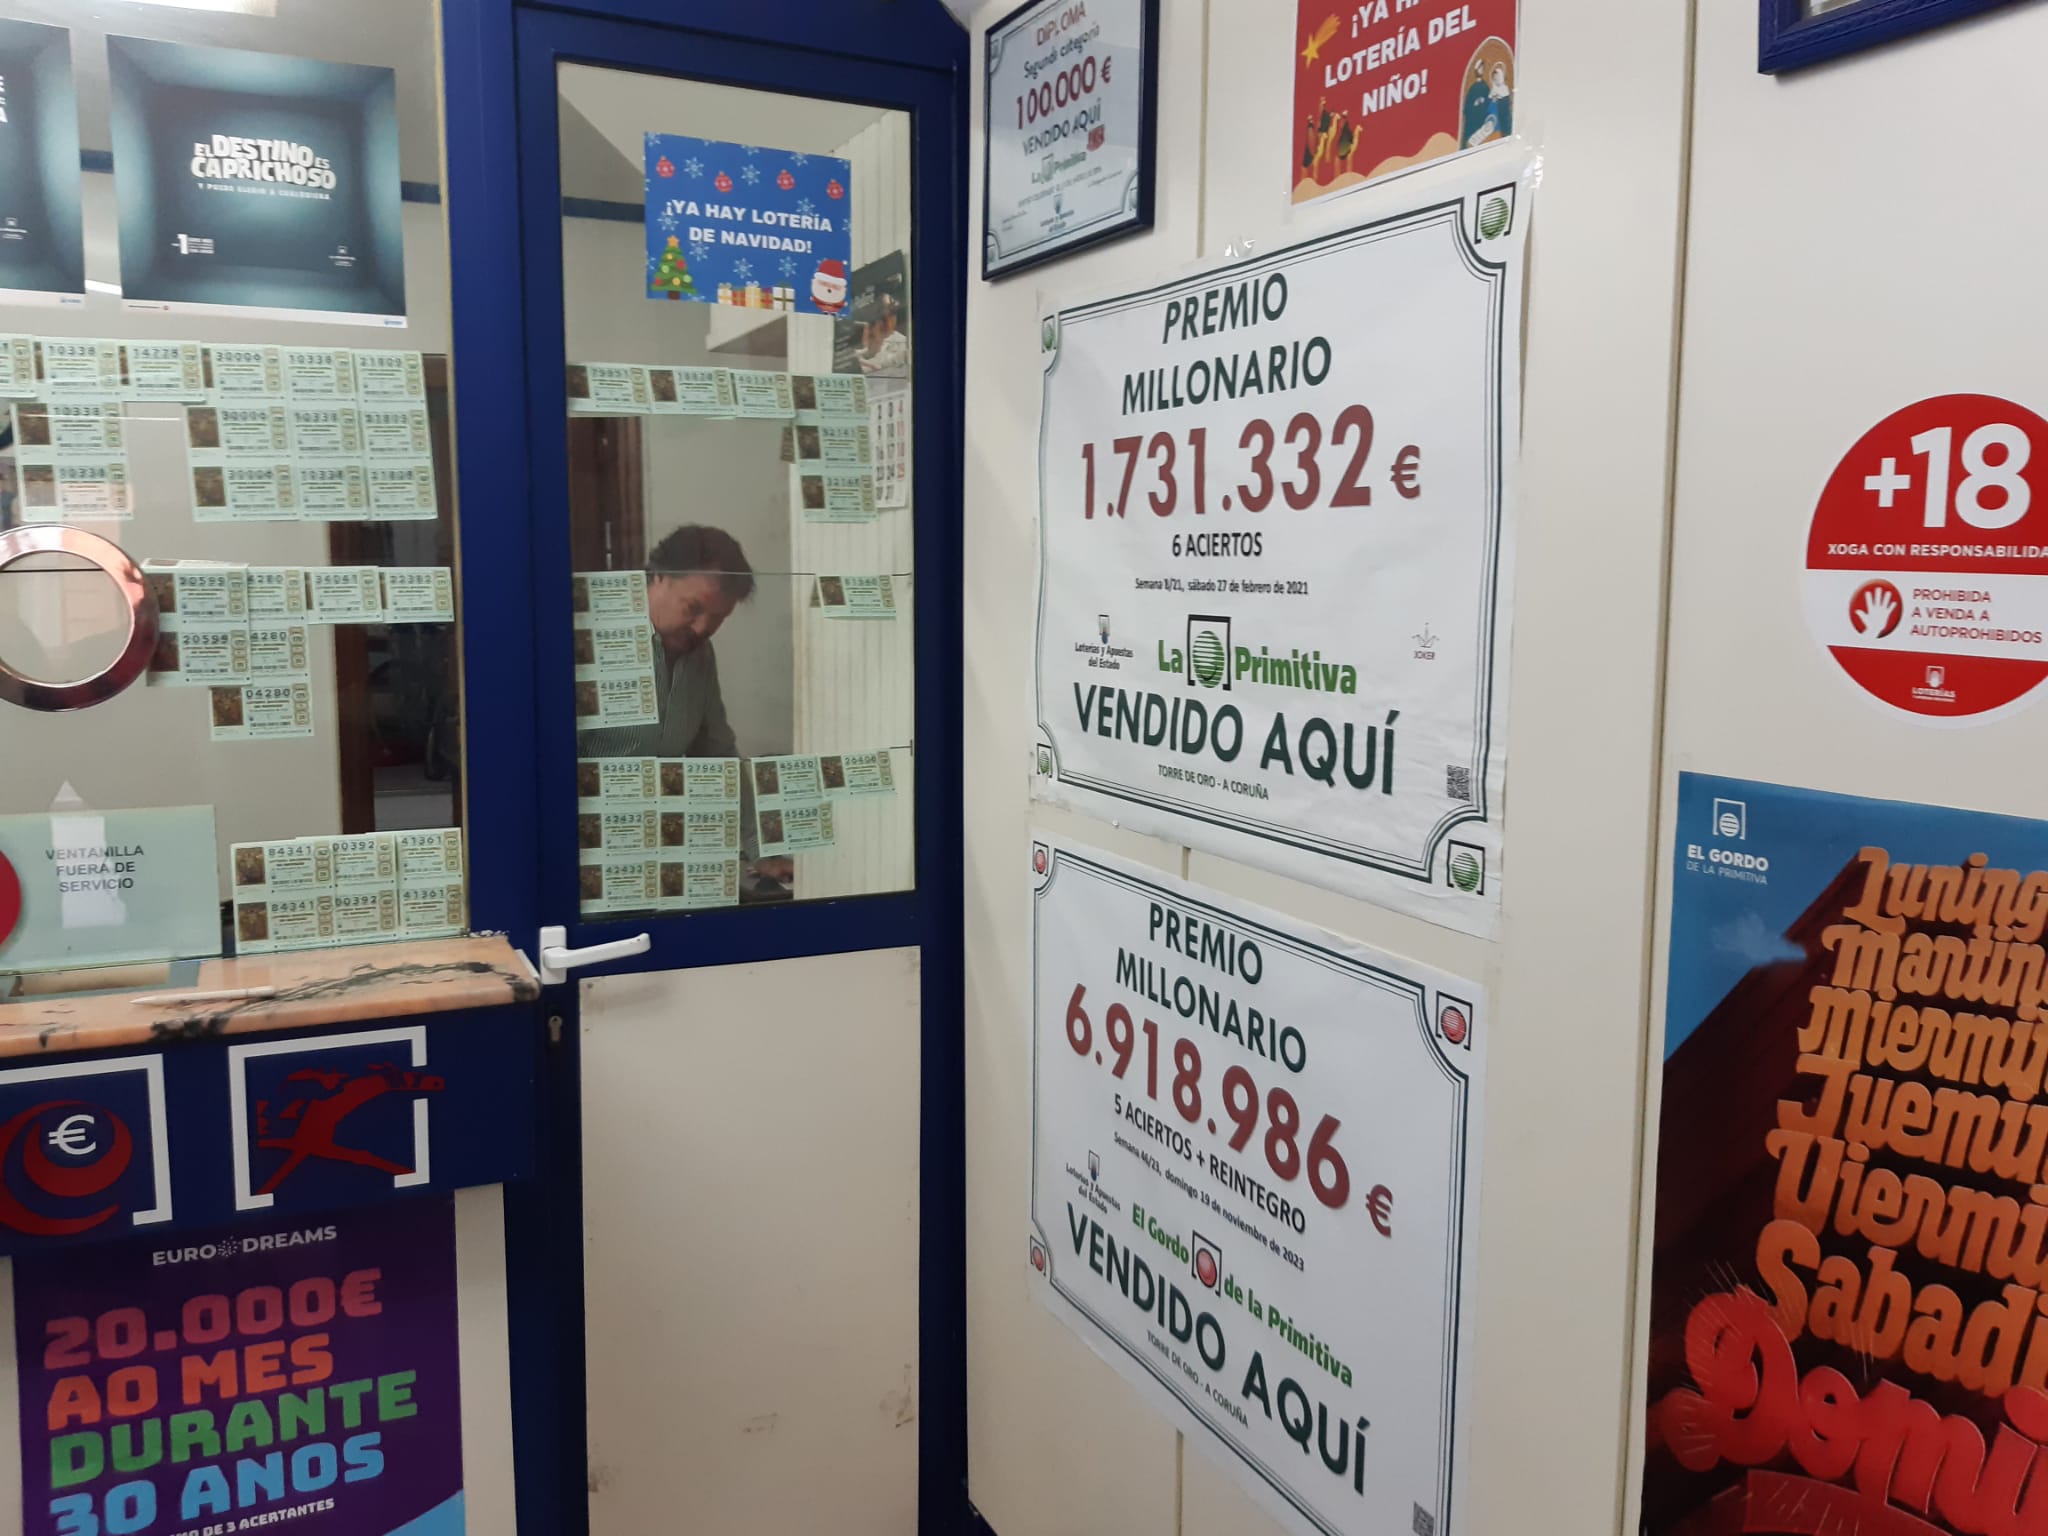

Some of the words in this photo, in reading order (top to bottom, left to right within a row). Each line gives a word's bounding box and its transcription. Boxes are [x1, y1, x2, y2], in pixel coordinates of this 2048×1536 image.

[1037, 1, 1086, 46] DIPLOMA
[1324, 25, 1421, 89] LOTERÍA
[1428, 4, 1477, 45] DEL
[1016, 55, 1096, 130] 100.000
[1101, 55, 1112, 83] €
[1361, 69, 1428, 117] NIÑO!
[194, 142, 213, 157] EL
[211, 134, 315, 168] DESTINO
[314, 157, 331, 169] ES
[1022, 119, 1070, 157] VENDIDO
[190, 156, 337, 190] CAPRICHOSO
[666, 199, 700, 216] ¡YA
[705, 203, 746, 221] HAY
[751, 209, 833, 233] LOTERÍA
[689, 226, 716, 244] DE
[721, 230, 813, 254] NAVIDAD!
[1162, 272, 1288, 344] PREMIO
[1122, 336, 1332, 415] MILLONARIO
[1081, 403, 1374, 520] 1.731.332
[1390, 445, 1421, 500] €
[1863, 422, 2032, 529] +18
[1172, 534, 1182, 557] 6
[1186, 532, 1263, 558] ACIERTOS
[1827, 542, 1869, 556] XOGA
[1873, 543, 1906, 556] CON
[1135, 577, 1163, 590] Semana
[1187, 578, 1216, 592] sábado
[1217, 579, 1228, 592] 27
[1229, 579, 1240, 592] de
[1241, 579, 1272, 594] febrero
[1273, 580, 1285, 594] de
[1286, 581, 1309, 595] 2021
[1913, 588, 1992, 603] PROHIBIDA
[1910, 624, 2043, 644] AUTOPROHIBIDOS
[1911, 606, 1922, 618] A
[1926, 607, 1975, 621] VENDA
[1980, 609, 1990, 621] A
[1158, 639, 1183, 674] La
[1235, 646, 1358, 695] Primitiva
[1073, 682, 1244, 762] VENDIDO
[1260, 709, 1401, 796] AQUÍ
[1158, 763, 1184, 781] TORRE
[1185, 770, 1196, 783] DE
[1197, 773, 1216, 788] ORO
[1222, 778, 1229, 792] A
[1231, 780, 1270, 801] CORUÑA
[46, 845, 144, 860] VENTANILLA
[56, 862, 110, 876] FUERA
[115, 861, 136, 873] DE
[1686, 860, 1699, 872] DE
[1703, 864, 1715, 875] LA
[1687, 844, 1705, 860] EL
[1709, 848, 1769, 872] GORDO
[59, 877, 134, 892] SERVICIO
[1149, 901, 1263, 985] PREMIO
[1116, 947, 1307, 1074] MILLONARIO
[1066, 983, 1350, 1210] 6.918.986
[1365, 1184, 1393, 1238] €
[1114, 1092, 1122, 1116] 5
[1125, 1101, 1192, 1162] ACIERTOS
[1197, 1149, 1205, 1168] +
[1210, 1153, 1306, 1235] REINTEGRO
[1113, 1131, 1140, 1158] Semana
[1165, 1167, 1199, 1201] domingo
[1200, 1190, 1210, 1207] 19
[1211, 1199, 1221, 1215] de
[1222, 1208, 1268, 1247] noviembre
[1269, 1238, 1281, 1257] de
[1282, 1246, 1305, 1272] 2023
[152, 1243, 217, 1266] EURO
[242, 1225, 338, 1254] DREAMS
[43, 1267, 383, 1370] 20.000€
[1132, 1202, 1145, 1231] El
[1148, 1215, 1190, 1265] Gordo
[1224, 1272, 1244, 1306] de
[1248, 1287, 1263, 1321] la
[1268, 1303, 1353, 1389] Primitiva
[1067, 1202, 1226, 1373] VENDIDO
[1241, 1350, 1370, 1497] AQUÍ
[47, 1364, 158, 1431] AO
[181, 1333, 334, 1406] MES
[1147, 1328, 1170, 1360] TORRE
[1171, 1351, 1181, 1369] DE
[1183, 1360, 1199, 1385] ORO
[1205, 1382, 1212, 1397] A
[1213, 1388, 1249, 1429] CORUÑA
[51, 1369, 418, 1490] DURANTE
[49, 1479, 158, 1536] 30
[181, 1431, 385, 1520] ANOS
[203, 1523, 223, 1536] DE
[226, 1521, 236, 1533] 3
[238, 1497, 336, 1530] ACERTANTES
